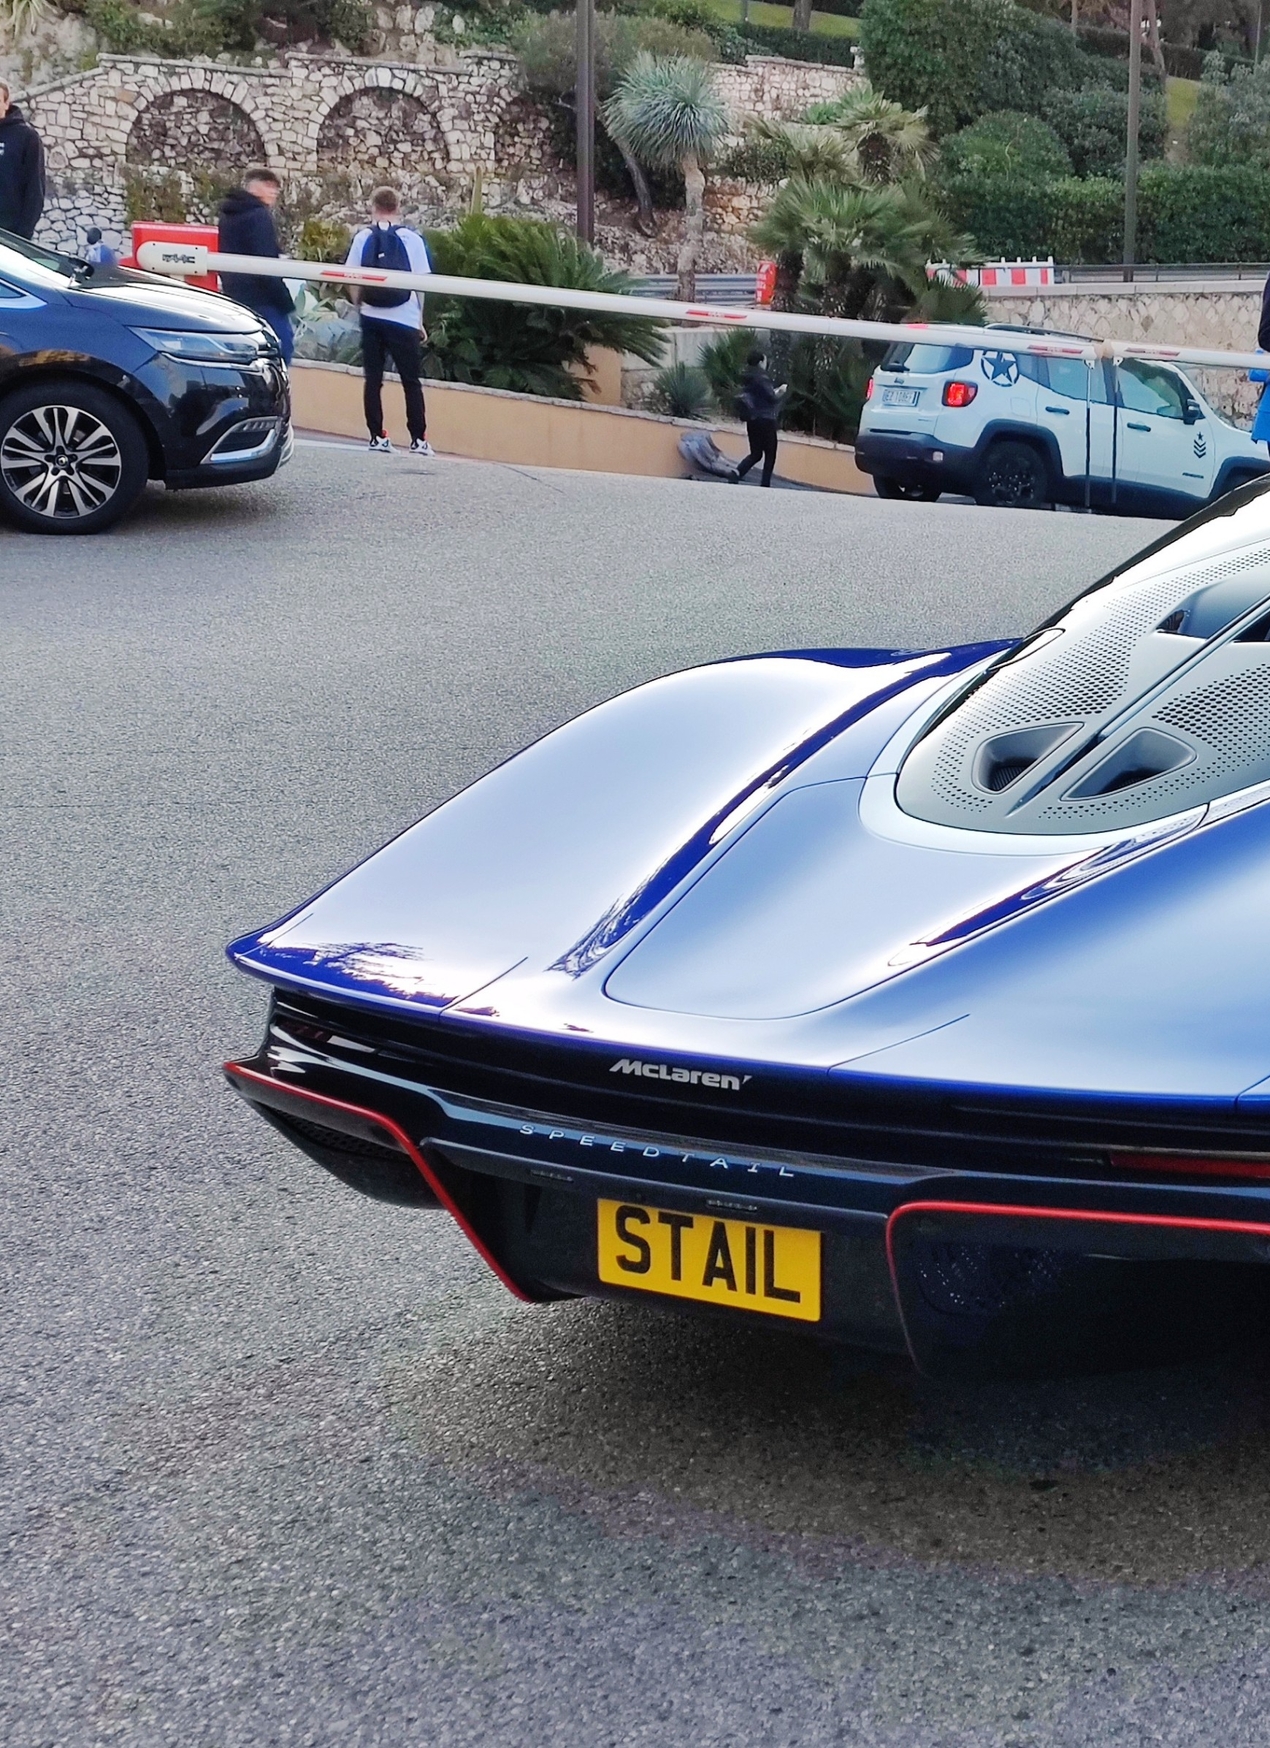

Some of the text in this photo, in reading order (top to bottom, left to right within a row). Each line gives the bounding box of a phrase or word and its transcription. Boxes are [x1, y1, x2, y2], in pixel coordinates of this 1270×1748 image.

[608, 1058, 741, 1091] McLaren
[519, 1124, 795, 1177] SPEEDTAIL
[615, 1205, 801, 1304] STAIL
